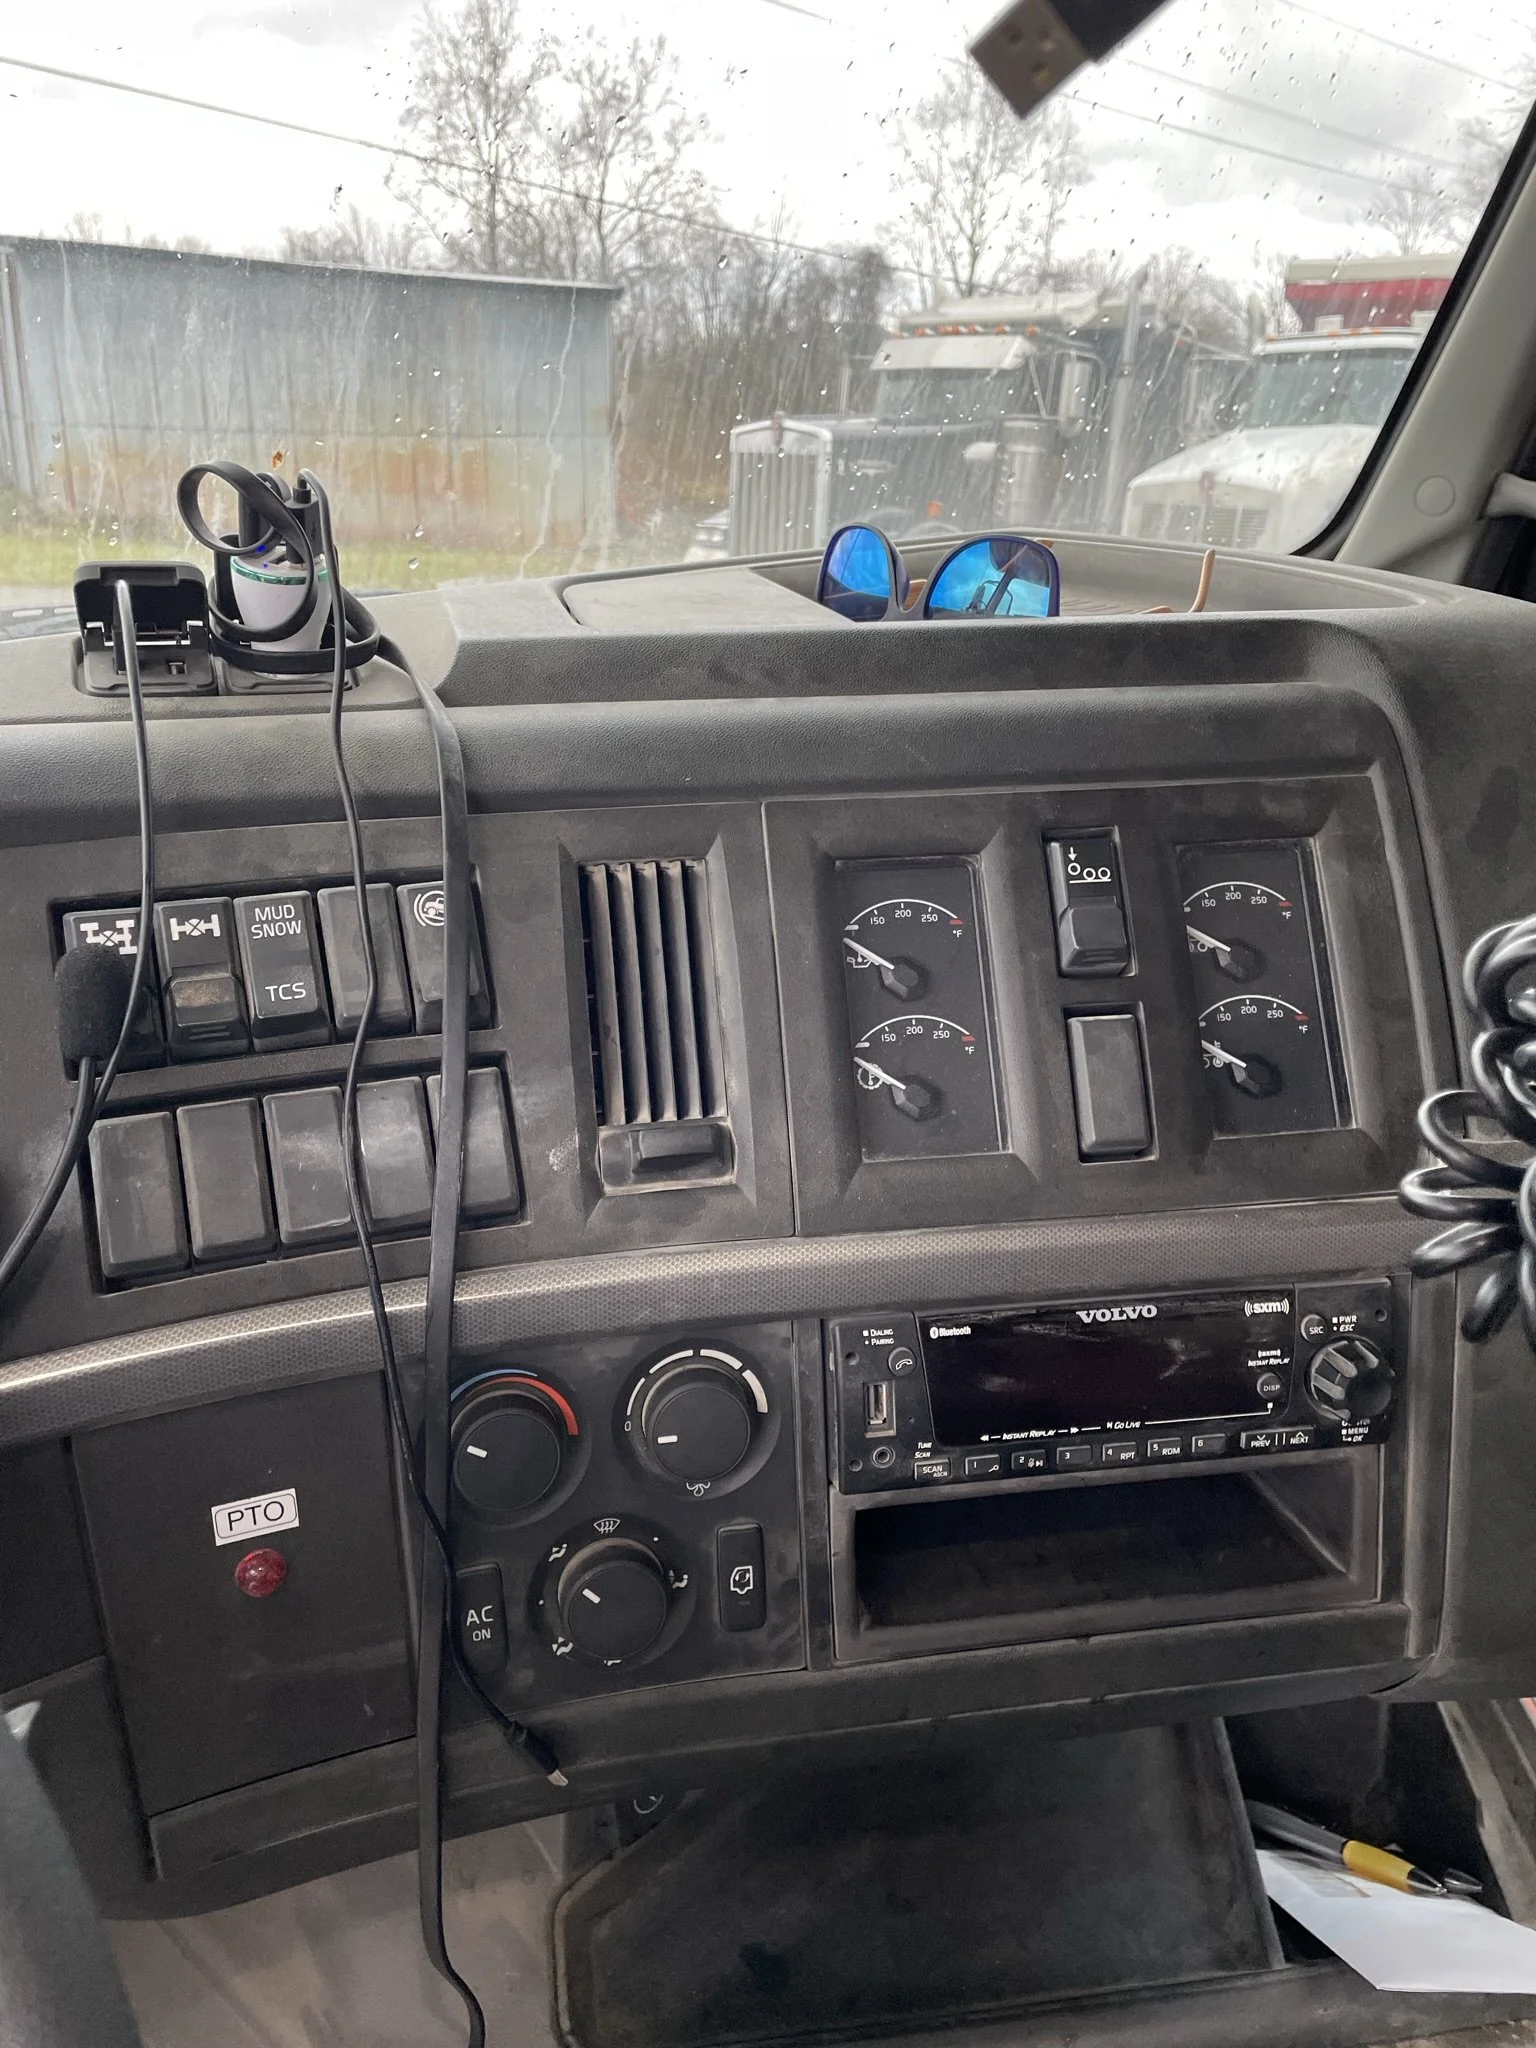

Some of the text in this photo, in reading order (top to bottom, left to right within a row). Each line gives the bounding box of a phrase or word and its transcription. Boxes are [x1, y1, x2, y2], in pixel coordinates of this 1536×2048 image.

[1201, 892, 1267, 908] 150 200 250
[254, 904, 295, 921] MUD
[870, 910, 938, 925] 150 200 250
[251, 919, 302, 939] SNOW
[265, 982, 307, 1002] TCS
[1217, 1005, 1283, 1022] 150 200 250
[881, 1026, 950, 1042] 150 200 250
[1075, 1304, 1158, 1324] VOLVO
[1339, 1315, 1357, 1323] PWR
[939, 1325, 972, 1337] Bluetooth
[1309, 1326, 1324, 1335] SRC
[1339, 1324, 1355, 1332] ESC
[1263, 1384, 1281, 1392] DISP
[1347, 1426, 1369, 1435] MENU
[1197, 1439, 1204, 1447] 6
[1250, 1440, 1271, 1448] PREV
[1289, 1436, 1309, 1445] NEXT
[1152, 1443, 1159, 1451] 5
[1019, 1456, 1025, 1464] 2
[1107, 1448, 1135, 1461] 4 RPT
[922, 1464, 943, 1474] SCAN
[227, 1500, 285, 1532] PTO
[466, 1605, 494, 1627] AC
[472, 1627, 491, 1642] ON
